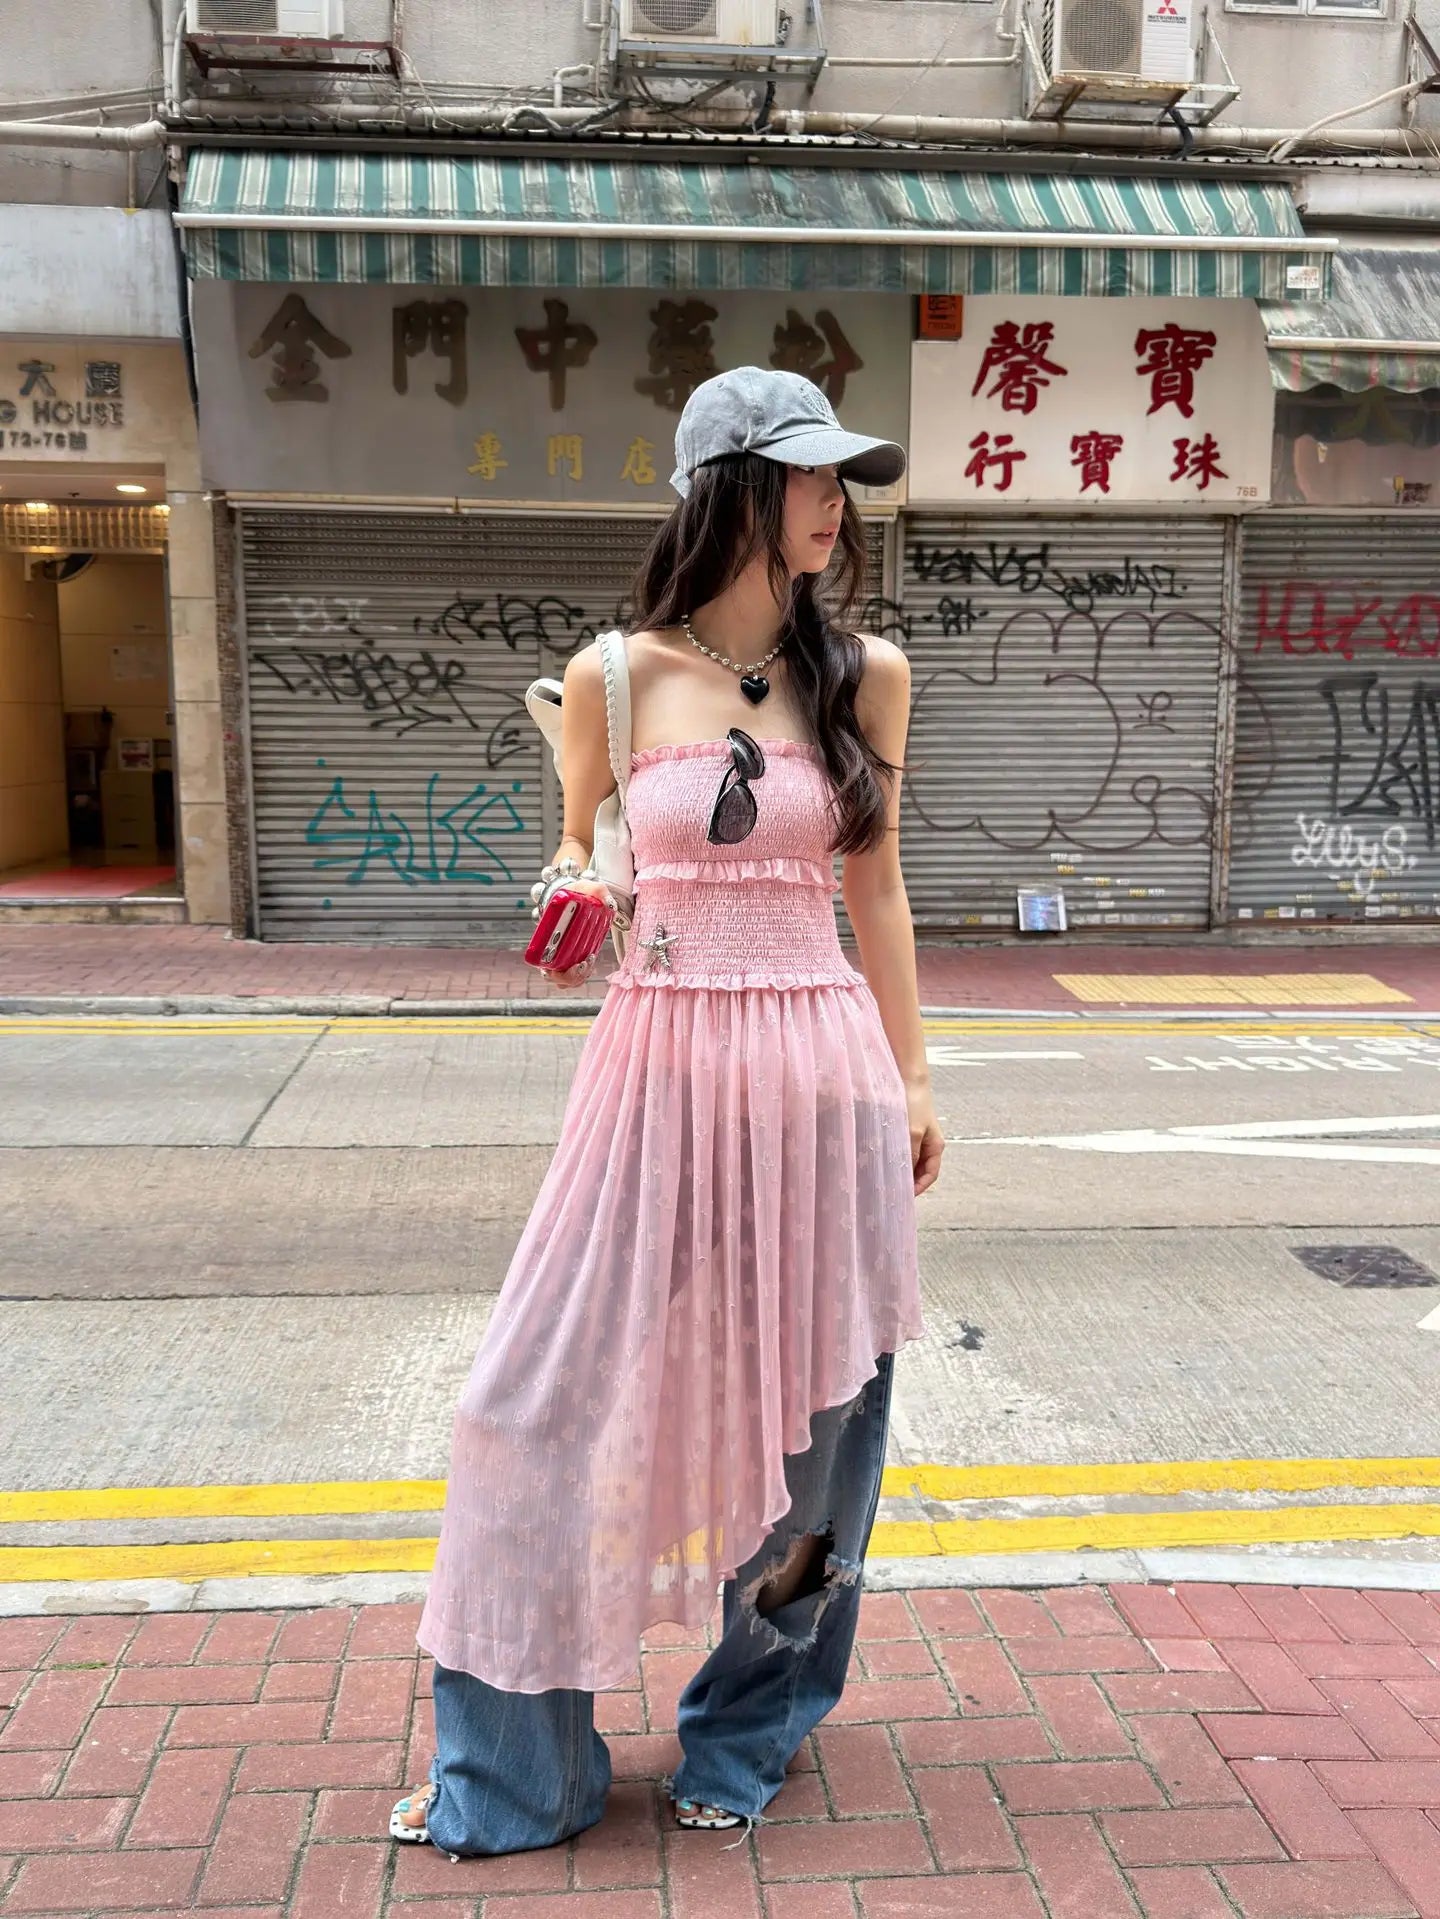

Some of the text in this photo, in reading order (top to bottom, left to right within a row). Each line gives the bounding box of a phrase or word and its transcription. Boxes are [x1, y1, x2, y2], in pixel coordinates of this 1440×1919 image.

[33, 401, 123, 426] HOUSE
[468, 432, 657, 484] 專門店
[1236, 486, 1258, 497] 76B
[1145, 1056, 1403, 1072] RIGHT
